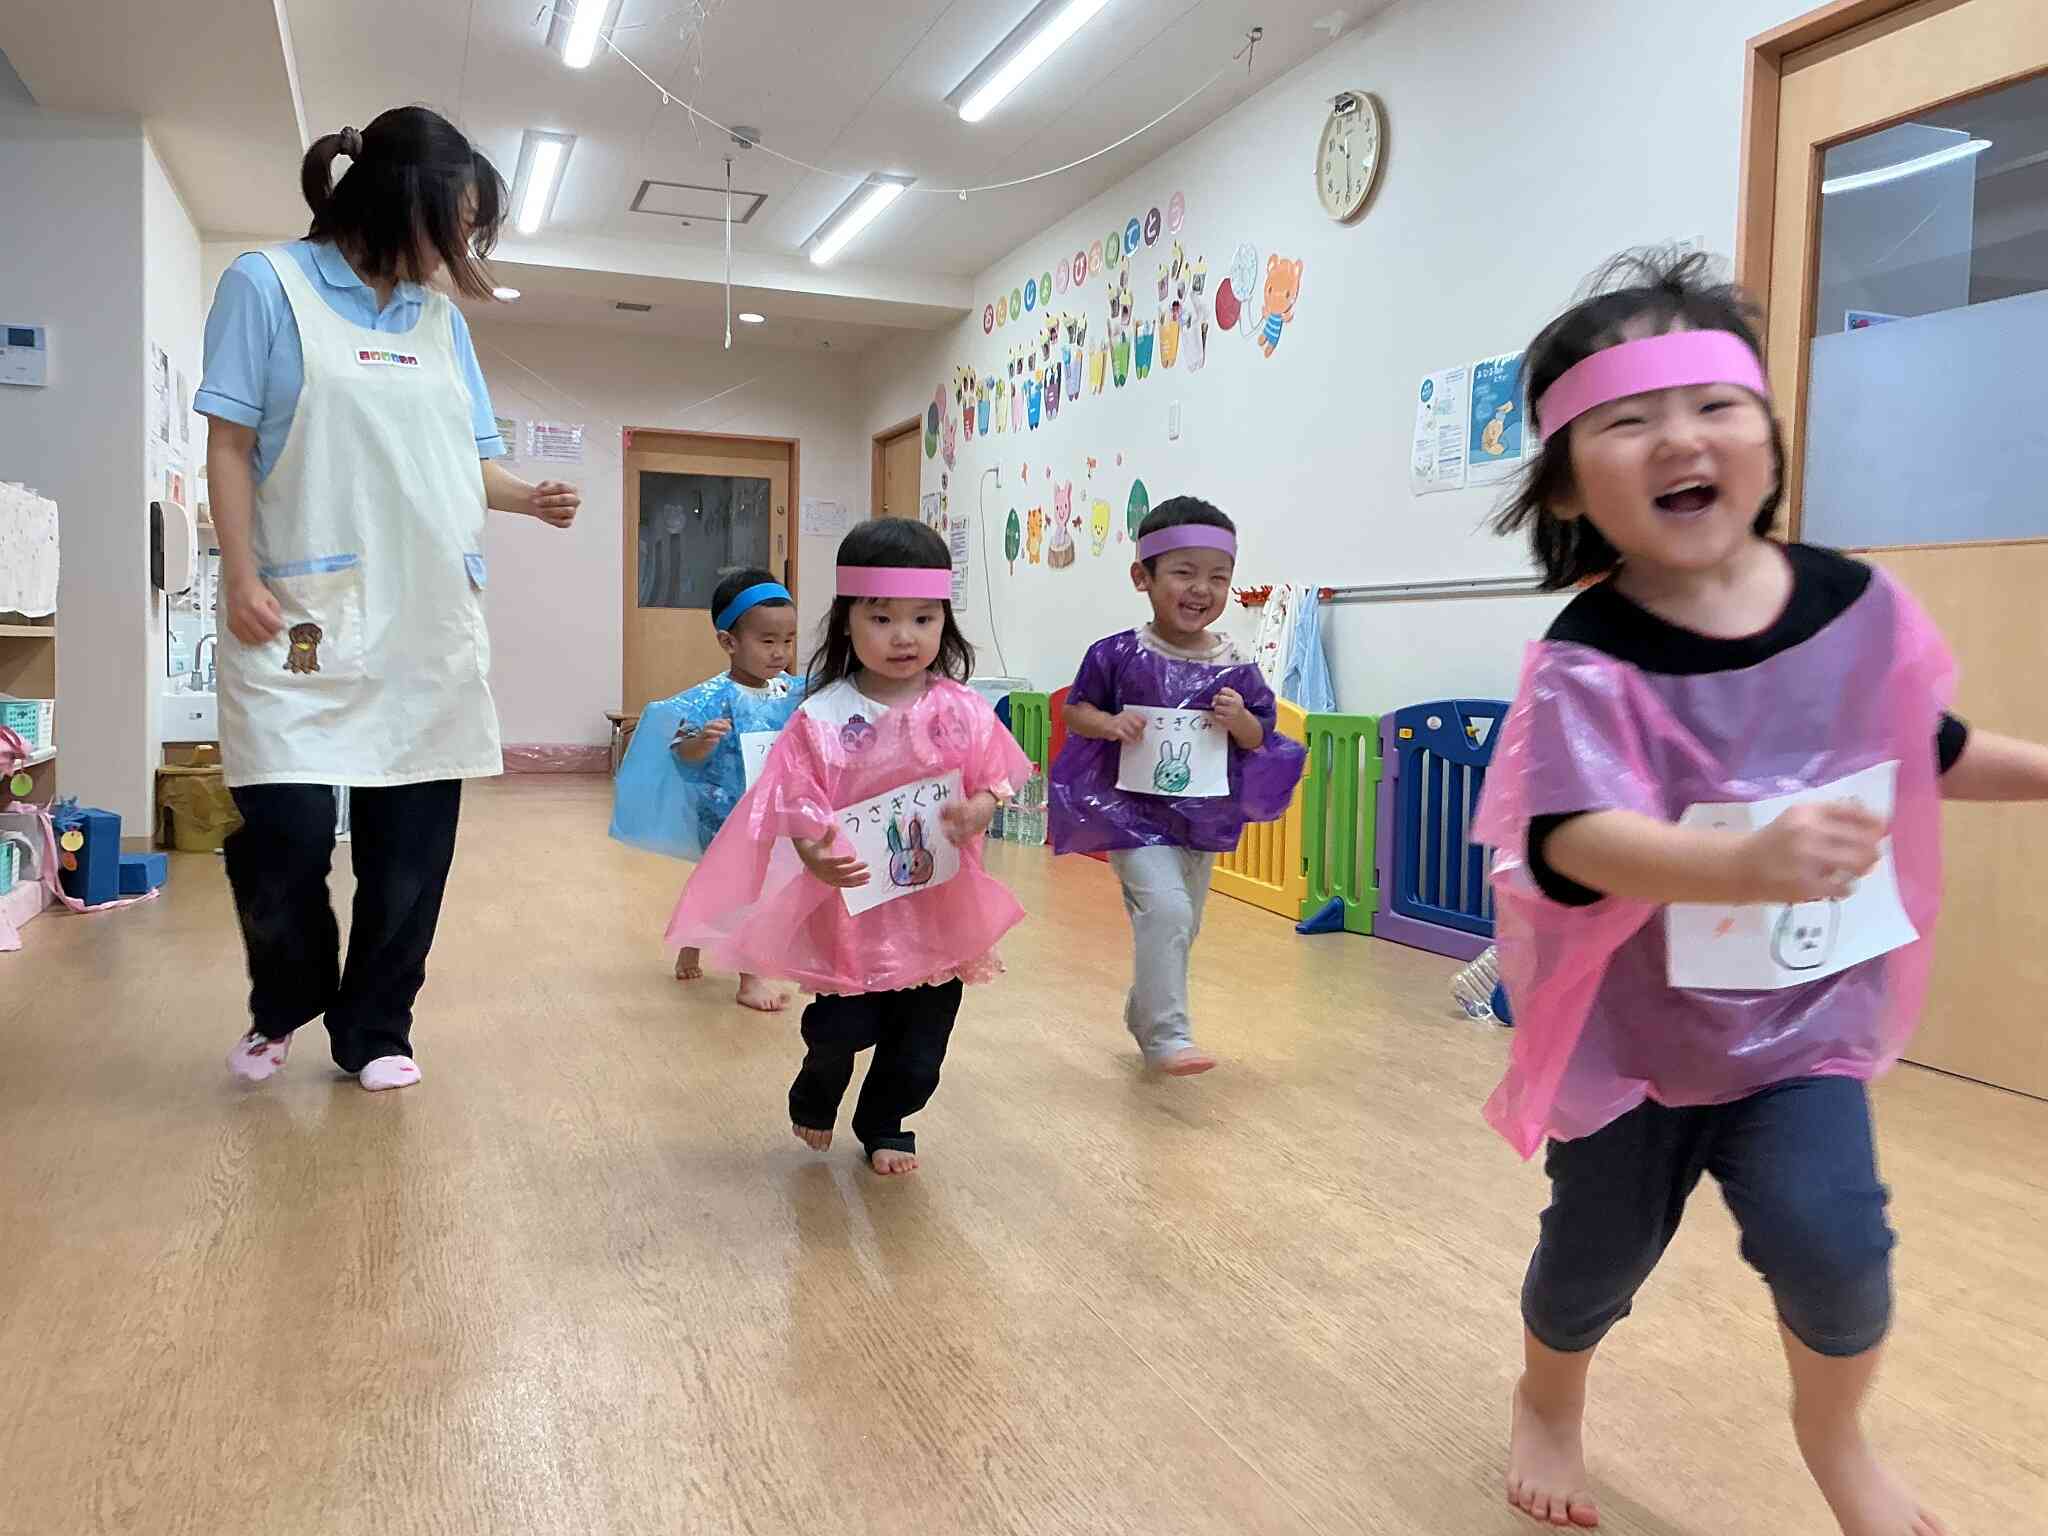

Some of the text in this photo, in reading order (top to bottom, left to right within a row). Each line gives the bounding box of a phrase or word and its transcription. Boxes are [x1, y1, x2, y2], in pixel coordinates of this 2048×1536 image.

[844, 783, 951, 833] うさぎぐみ
